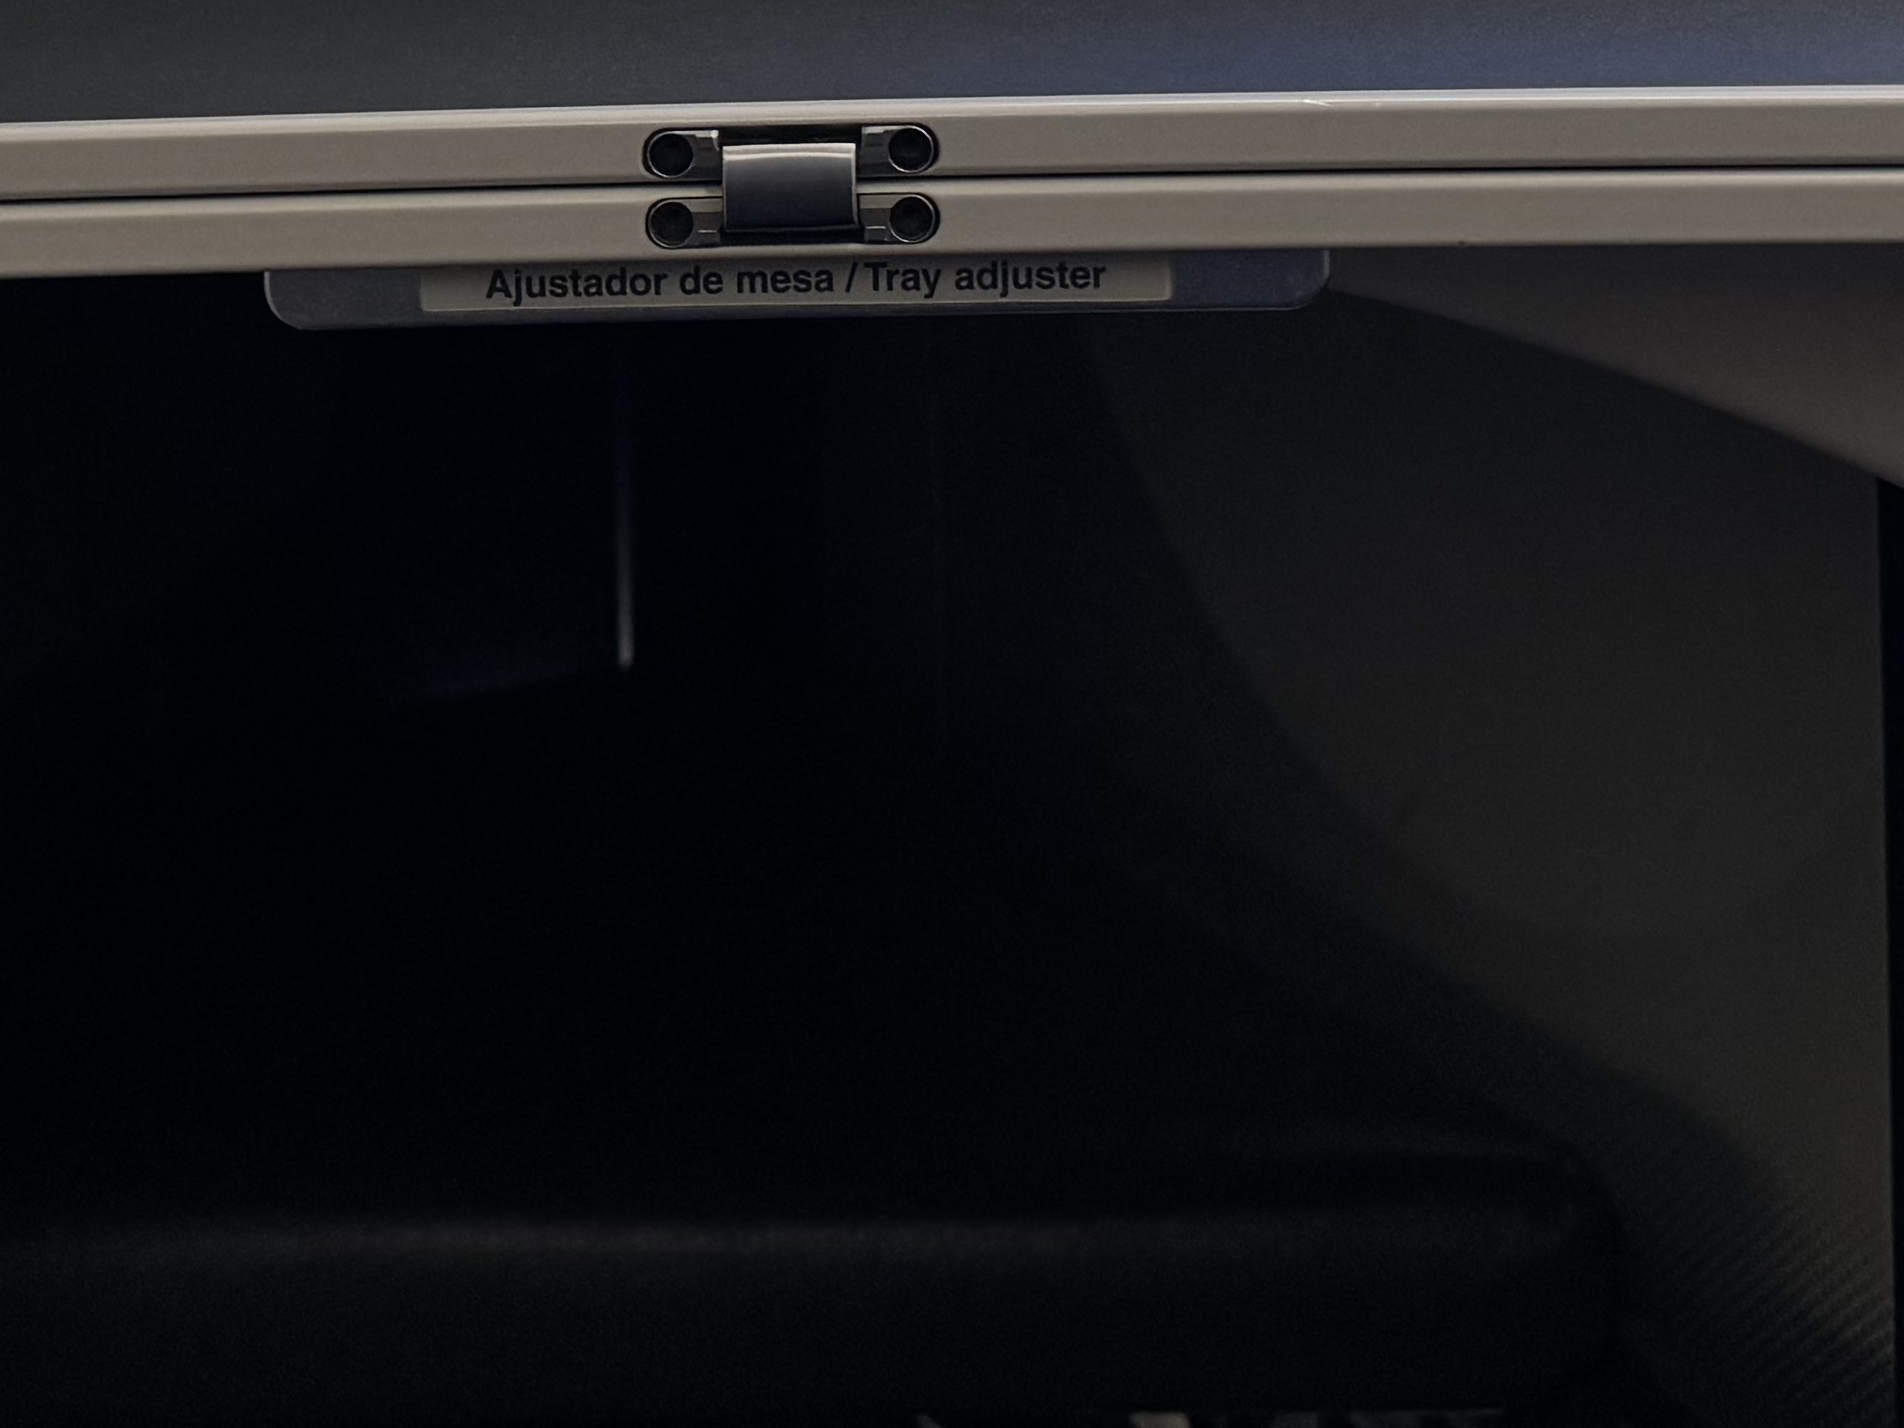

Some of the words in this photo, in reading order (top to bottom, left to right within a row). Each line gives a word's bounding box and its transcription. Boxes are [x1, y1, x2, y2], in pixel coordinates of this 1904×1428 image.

[486, 266, 670, 305] Ajustador
[679, 266, 723, 294] de
[736, 269, 835, 294] mesa
[845, 260, 858, 293] /
[864, 263, 942, 298] Tray
[954, 260, 1106, 297] adjuster
